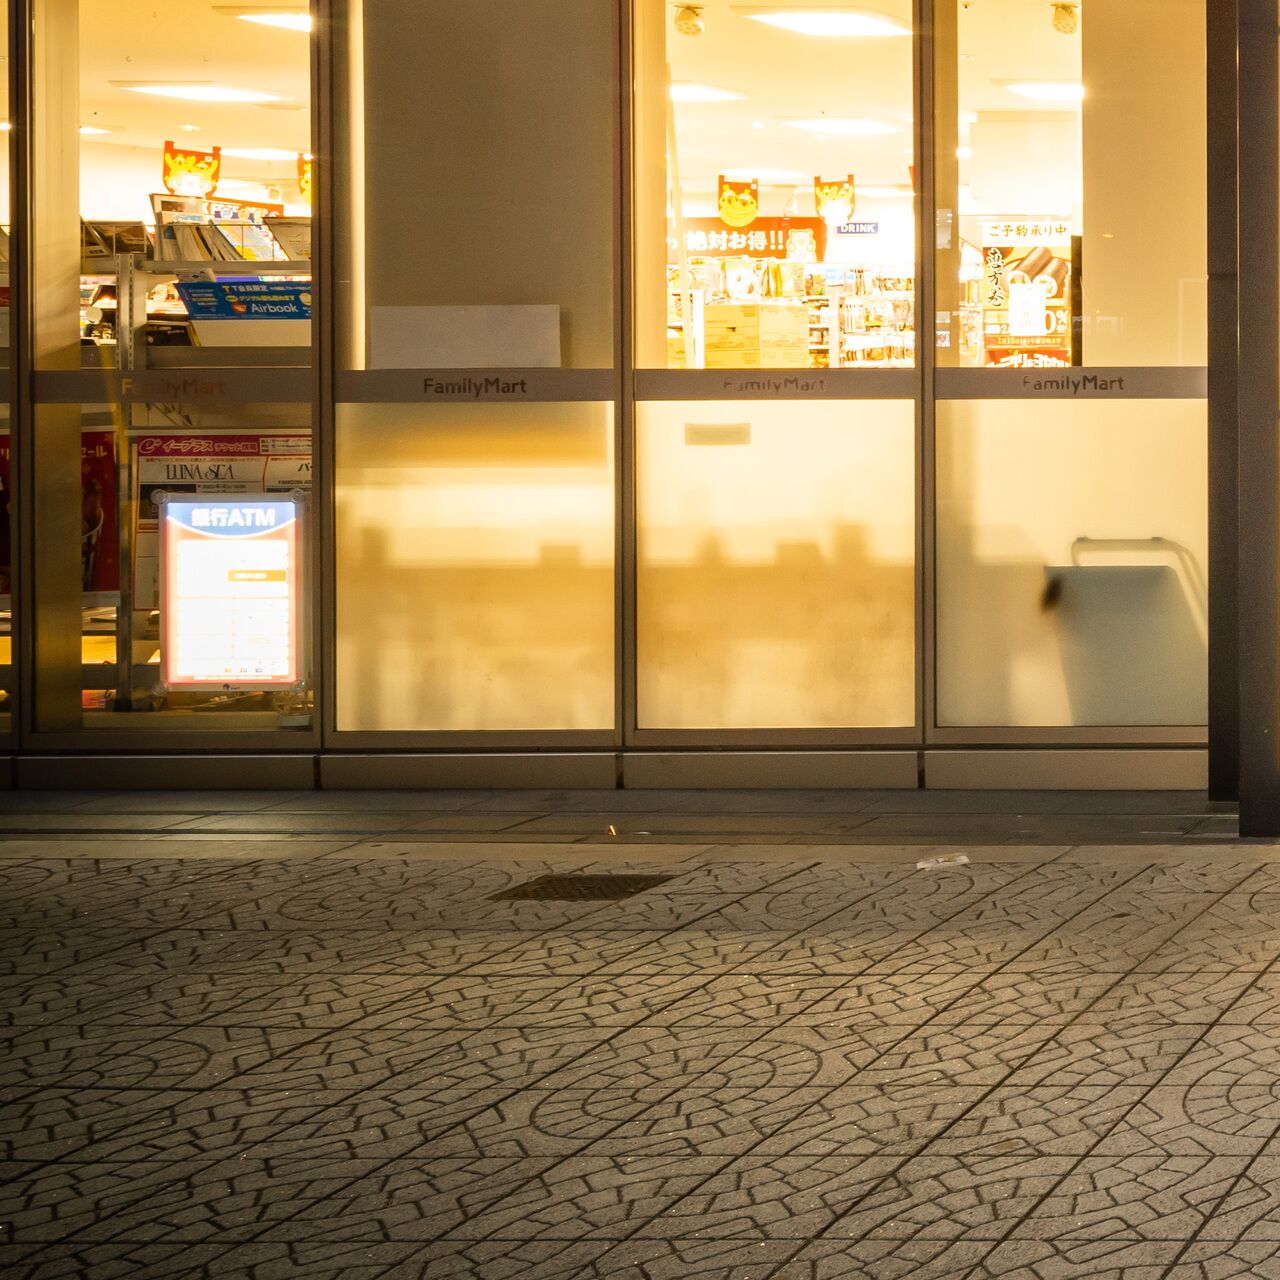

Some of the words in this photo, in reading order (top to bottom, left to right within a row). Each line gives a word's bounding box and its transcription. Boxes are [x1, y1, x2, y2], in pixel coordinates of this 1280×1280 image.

[841, 223, 875, 233] DRINK
[989, 224, 1068, 238] ご予約承り中
[251, 303, 299, 314] Airbook
[121, 378, 226, 398] FilyMart
[423, 377, 527, 398] FamilyMart
[1022, 375, 1125, 395] FamilyMart
[166, 463, 203, 480] LUNA
[205, 463, 235, 480] SEA
